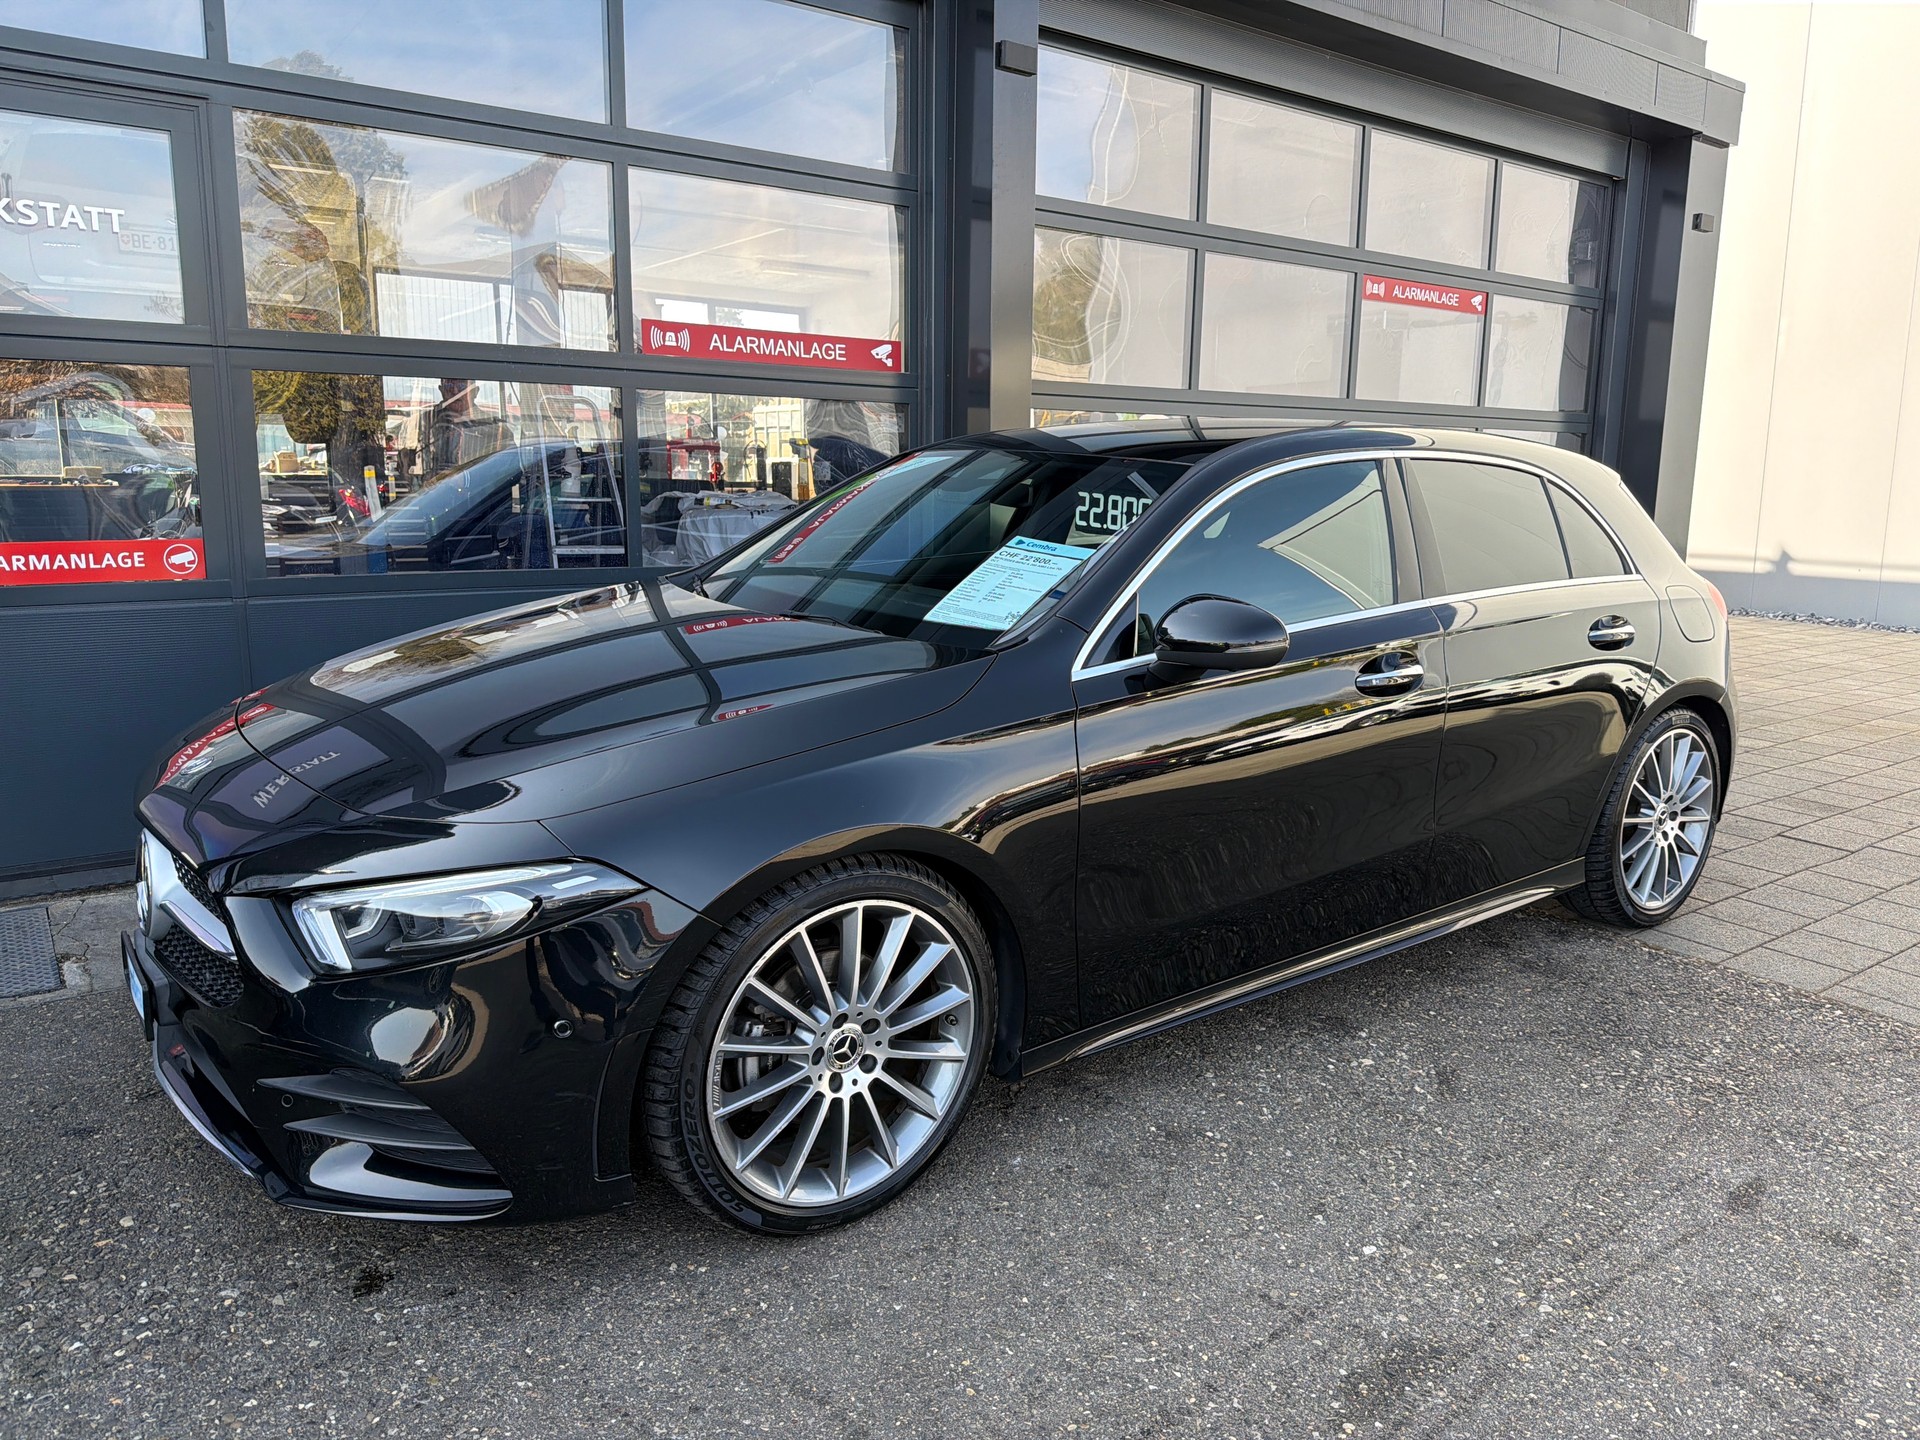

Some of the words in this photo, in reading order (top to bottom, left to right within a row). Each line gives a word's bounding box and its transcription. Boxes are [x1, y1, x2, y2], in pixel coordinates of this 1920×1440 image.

[0, 197, 125, 234] KSTATT
[1392, 285, 1460, 306] ALARMANLAGE
[709, 333, 847, 361] ALARMANLAGE
[999, 550, 1021, 560] CHF
[1026, 541, 1058, 552] Cembra
[0, 551, 146, 572] ARMANLAGE
[684, 1078, 746, 1214] SOTTOZERO
